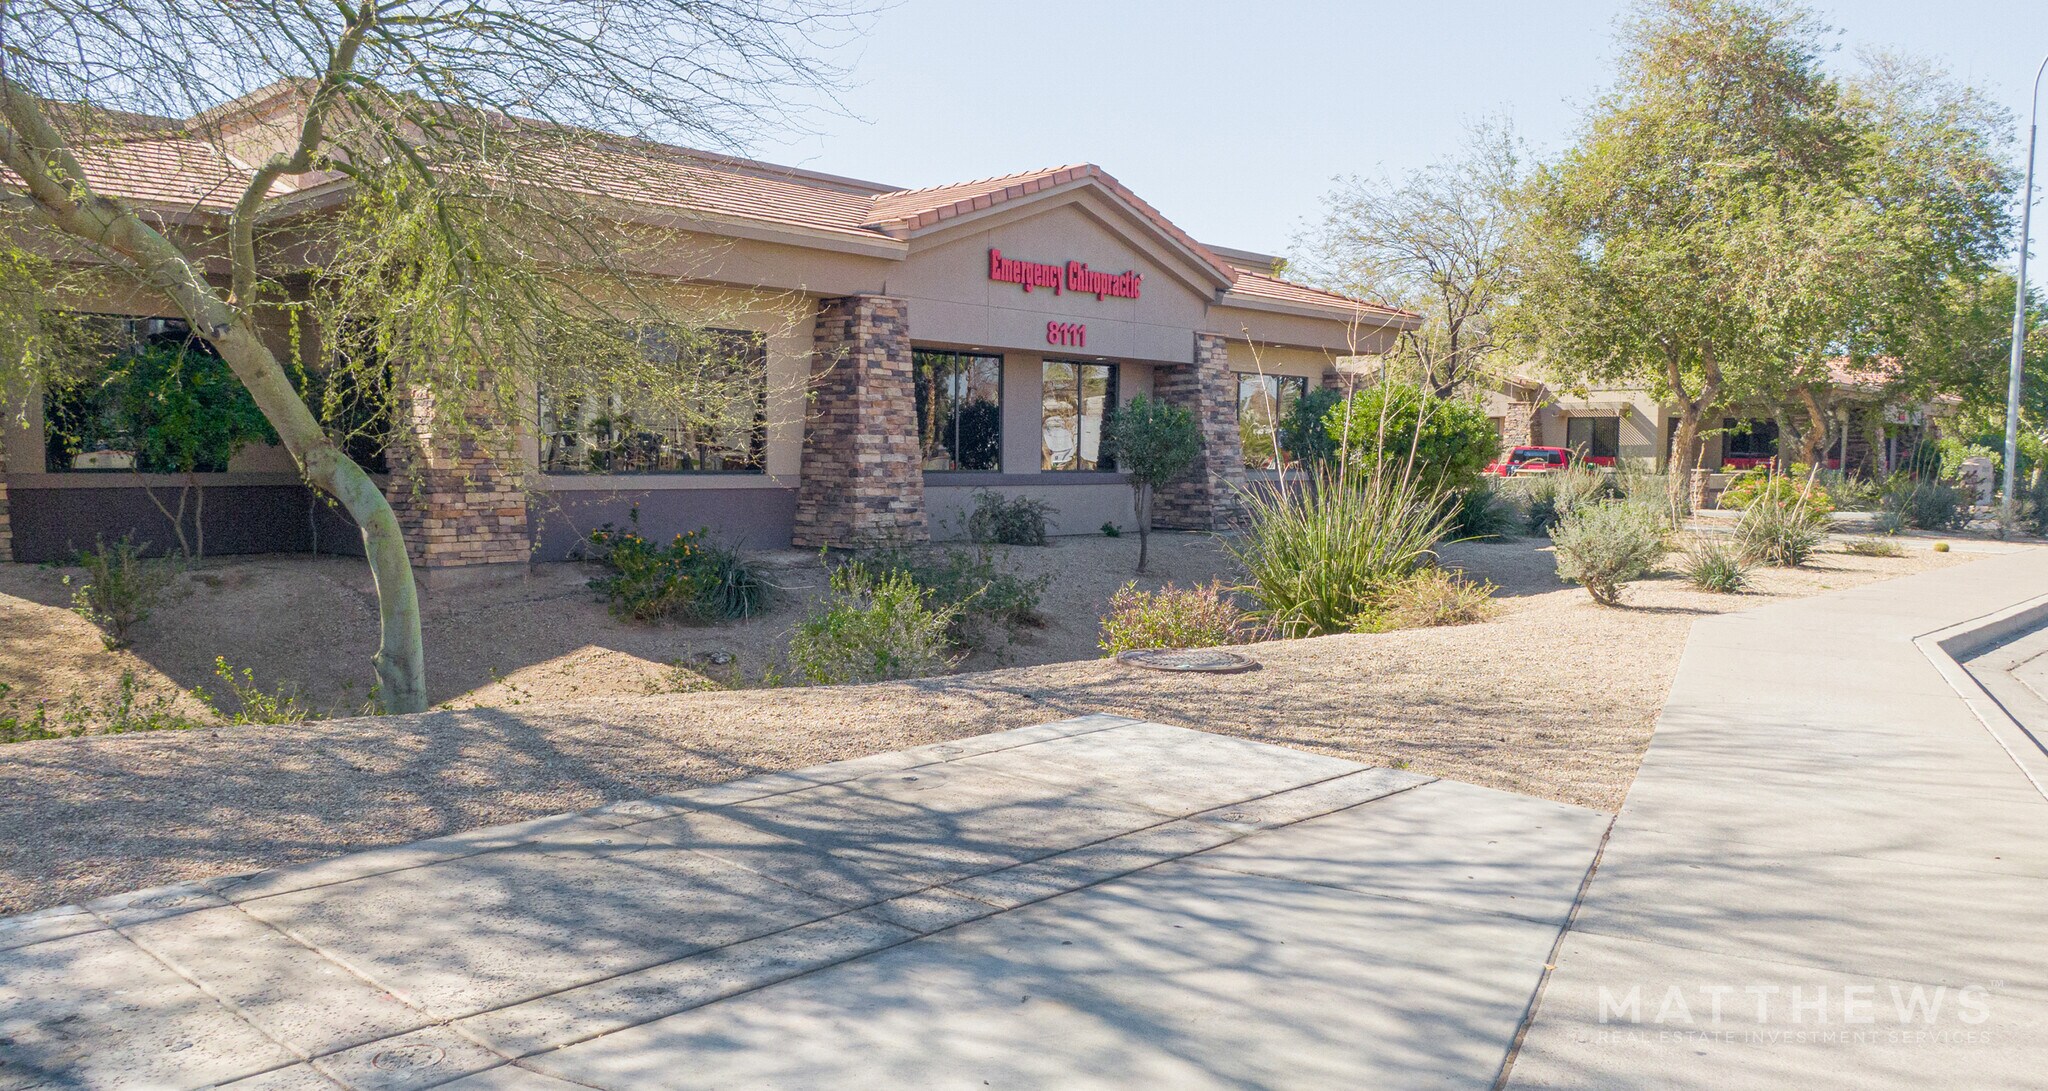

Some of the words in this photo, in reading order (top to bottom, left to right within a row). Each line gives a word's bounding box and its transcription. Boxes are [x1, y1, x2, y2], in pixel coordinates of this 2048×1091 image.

[990, 248, 1063, 295] Emergency
[1067, 260, 1141, 301] Chiropractic
[1046, 321, 1086, 347] 8111
